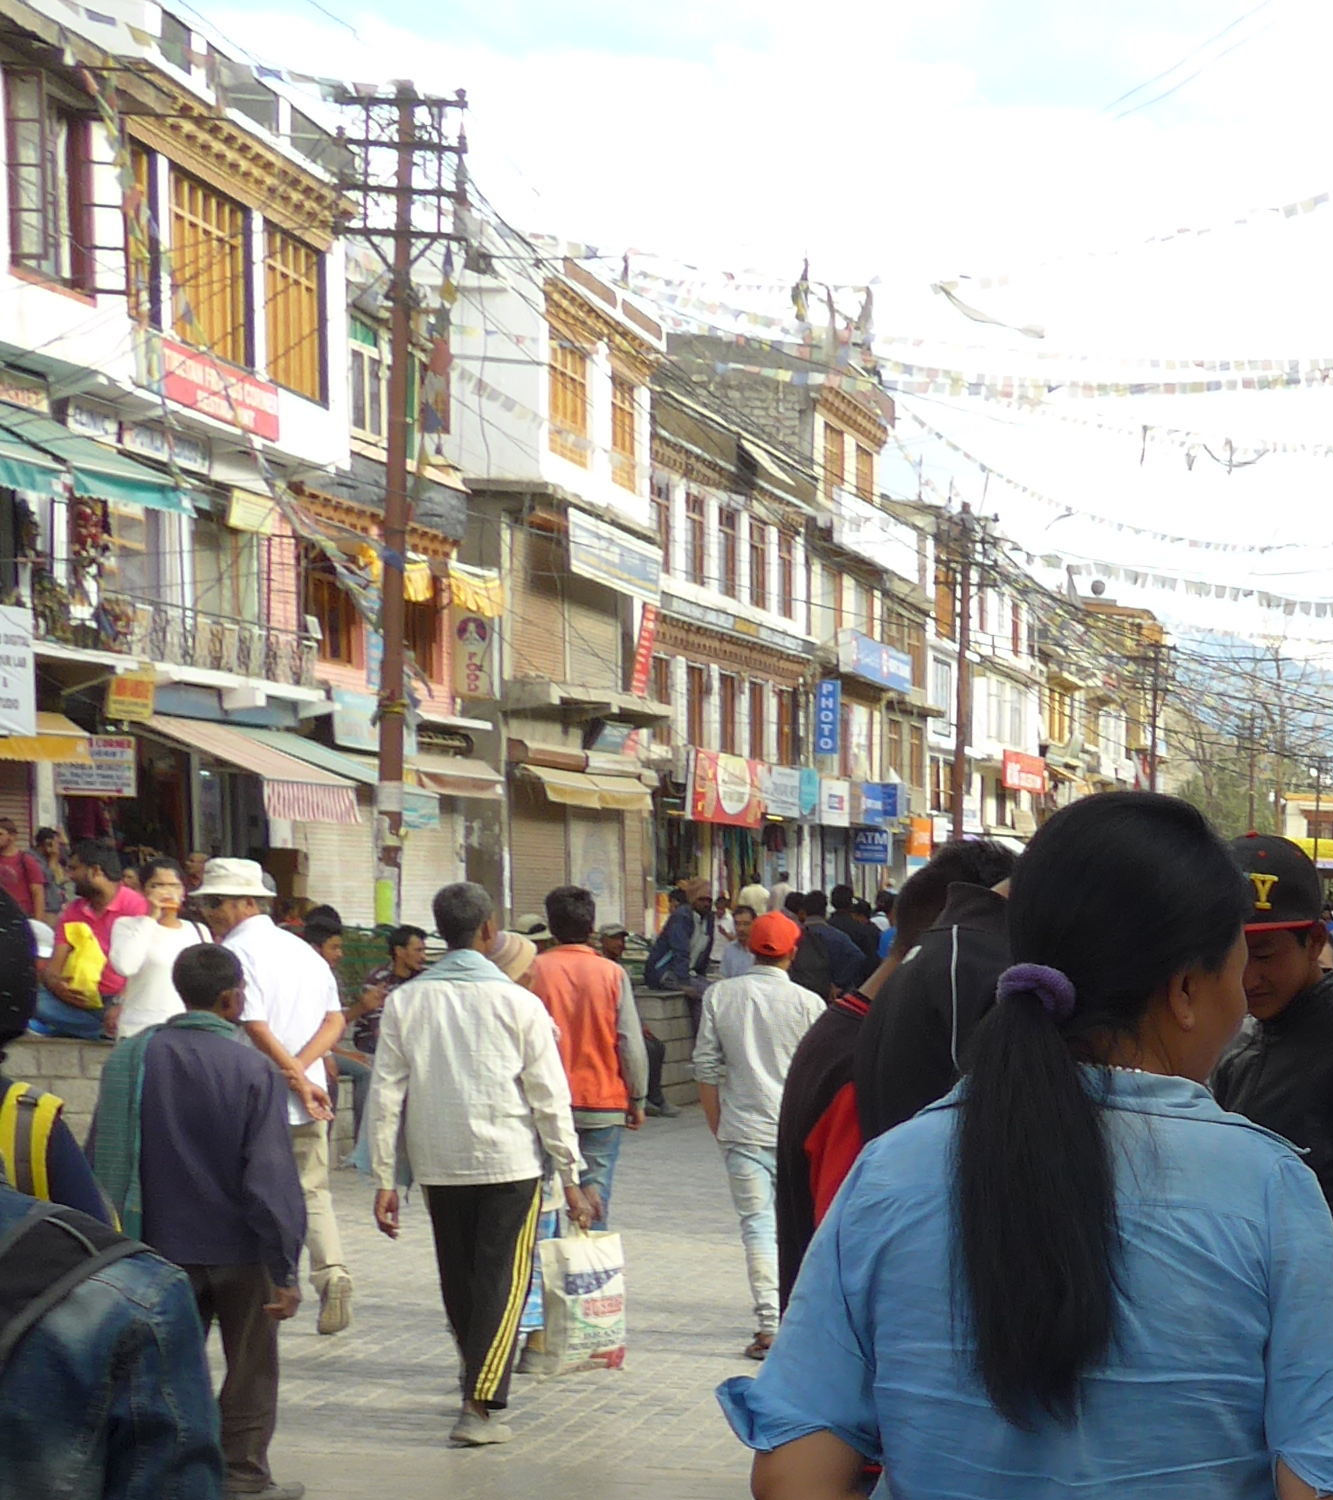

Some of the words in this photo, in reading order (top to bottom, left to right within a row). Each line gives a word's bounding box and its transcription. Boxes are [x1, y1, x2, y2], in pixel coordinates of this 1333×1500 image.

[466, 651, 481, 693] FOOD
[820, 682, 834, 750] PHOTO
[855, 830, 888, 845] ATM
